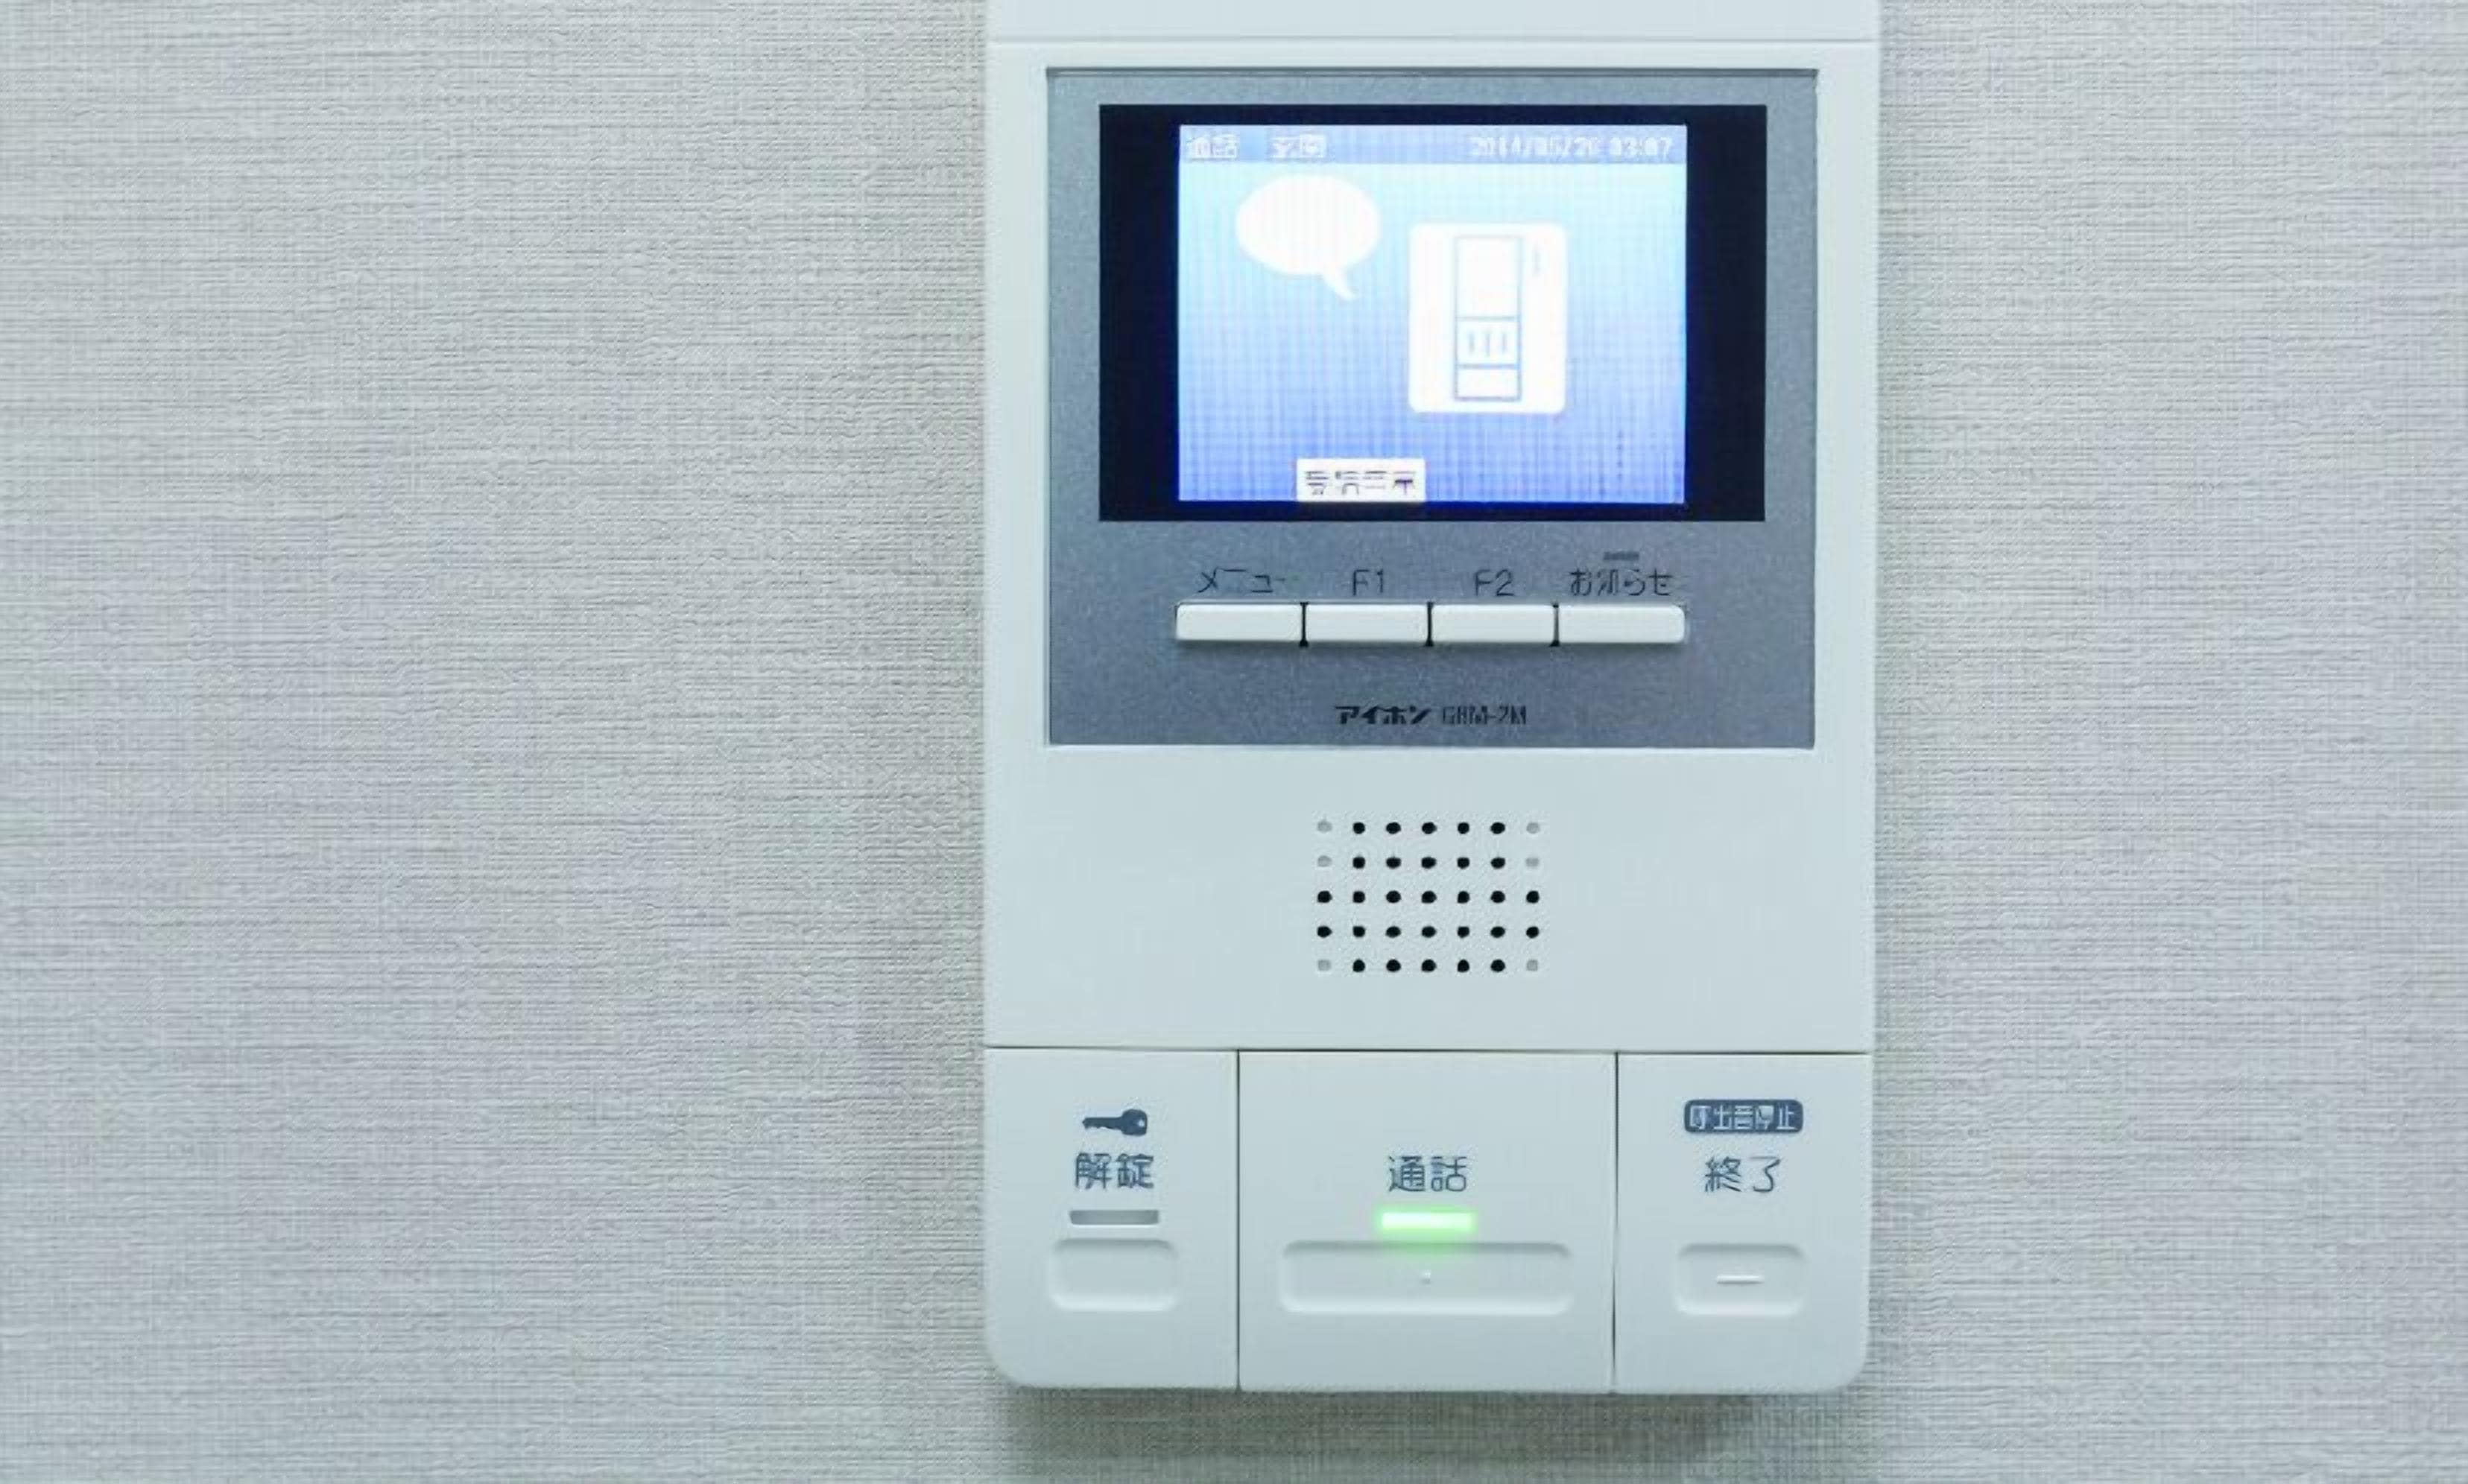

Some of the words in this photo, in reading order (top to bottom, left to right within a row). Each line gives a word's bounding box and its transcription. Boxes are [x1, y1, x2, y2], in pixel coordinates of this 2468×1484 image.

[1352, 568, 1384, 595] F1
[1475, 568, 1515, 596] F2
[1569, 568, 1674, 596] お知らせ
[1335, 705, 1431, 725] アイホン
[1075, 1152, 1154, 1190] 解錠
[1388, 1155, 1467, 1192] 通話
[1704, 1155, 1781, 1193] 終了
